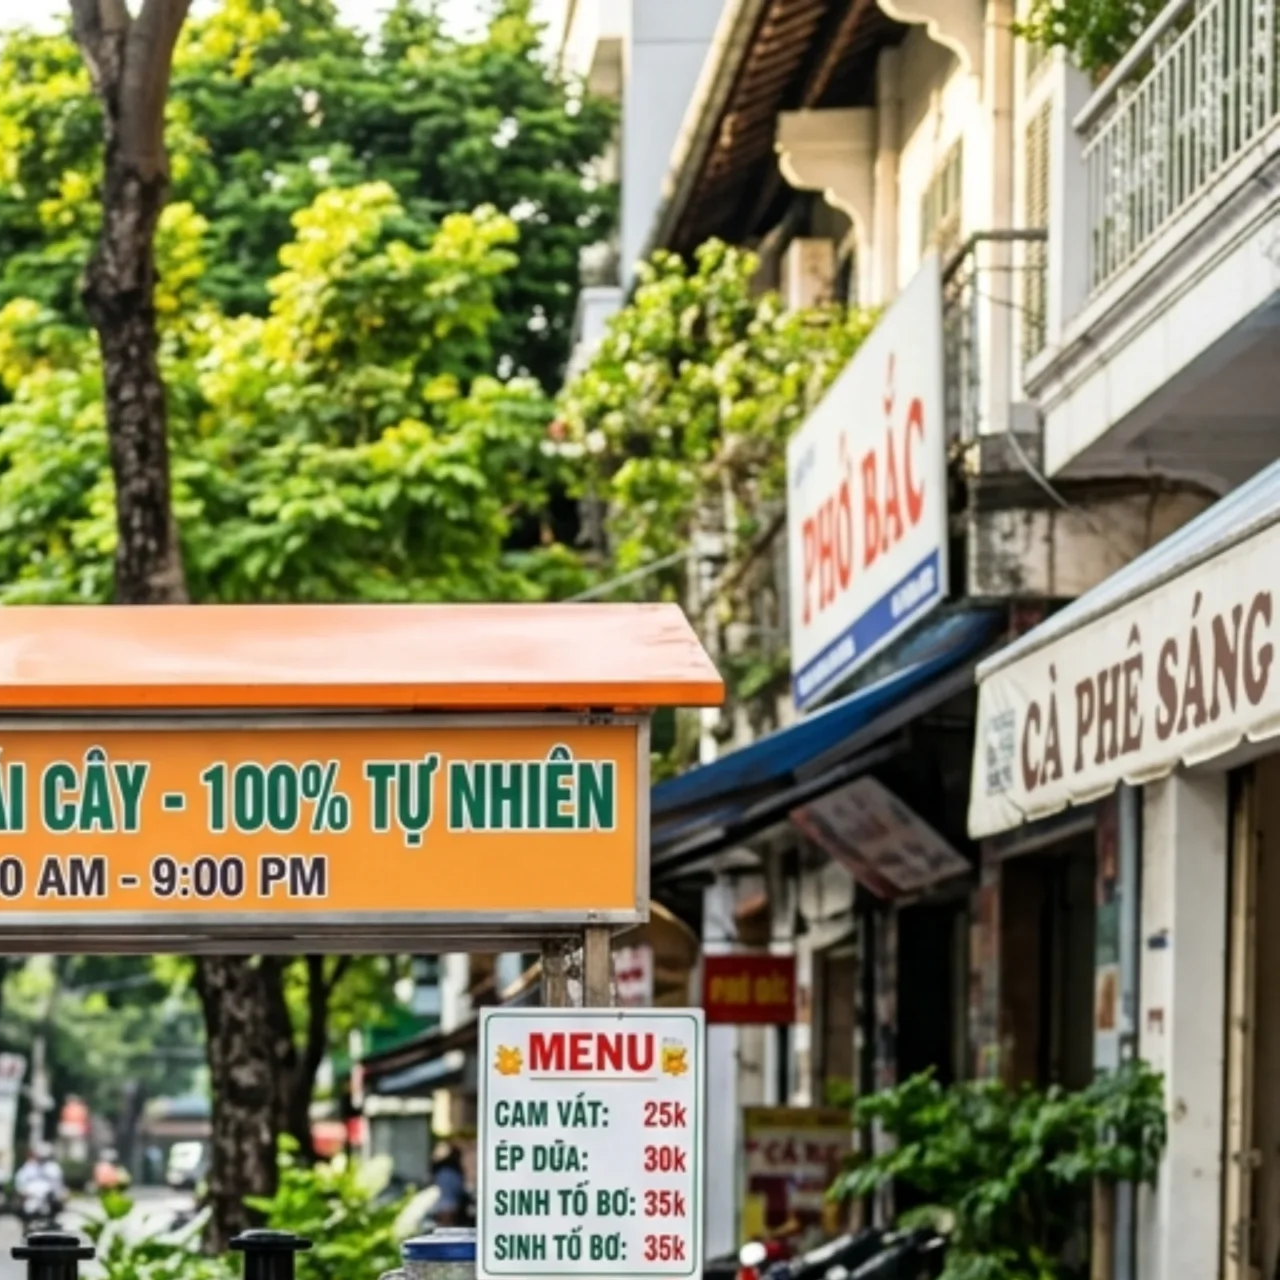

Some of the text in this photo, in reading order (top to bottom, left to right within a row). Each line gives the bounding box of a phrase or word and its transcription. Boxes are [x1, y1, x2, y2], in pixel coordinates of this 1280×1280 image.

[1021, 661, 1063, 792] CÀ
[1074, 622, 1143, 773] PHÊ
[1155, 590, 1274, 741] SÁNG
[43, 748, 148, 832] CÂY
[201, 762, 349, 832] 100%
[366, 754, 439, 845] TỰ
[449, 745, 614, 831] NHIÊN
[36, 856, 106, 897] AM
[152, 856, 244, 897] 9:00
[260, 856, 327, 897] PM
[528, 1032, 654, 1072] MENU
[494, 1100, 548, 1128] CAM
[643, 1101, 687, 1128] 25k
[643, 1145, 687, 1172] 30k
[494, 1189, 550, 1216] SINH
[643, 1189, 686, 1217] 35k
[494, 1234, 546, 1261] SINH
[643, 1234, 686, 1261] 35k
